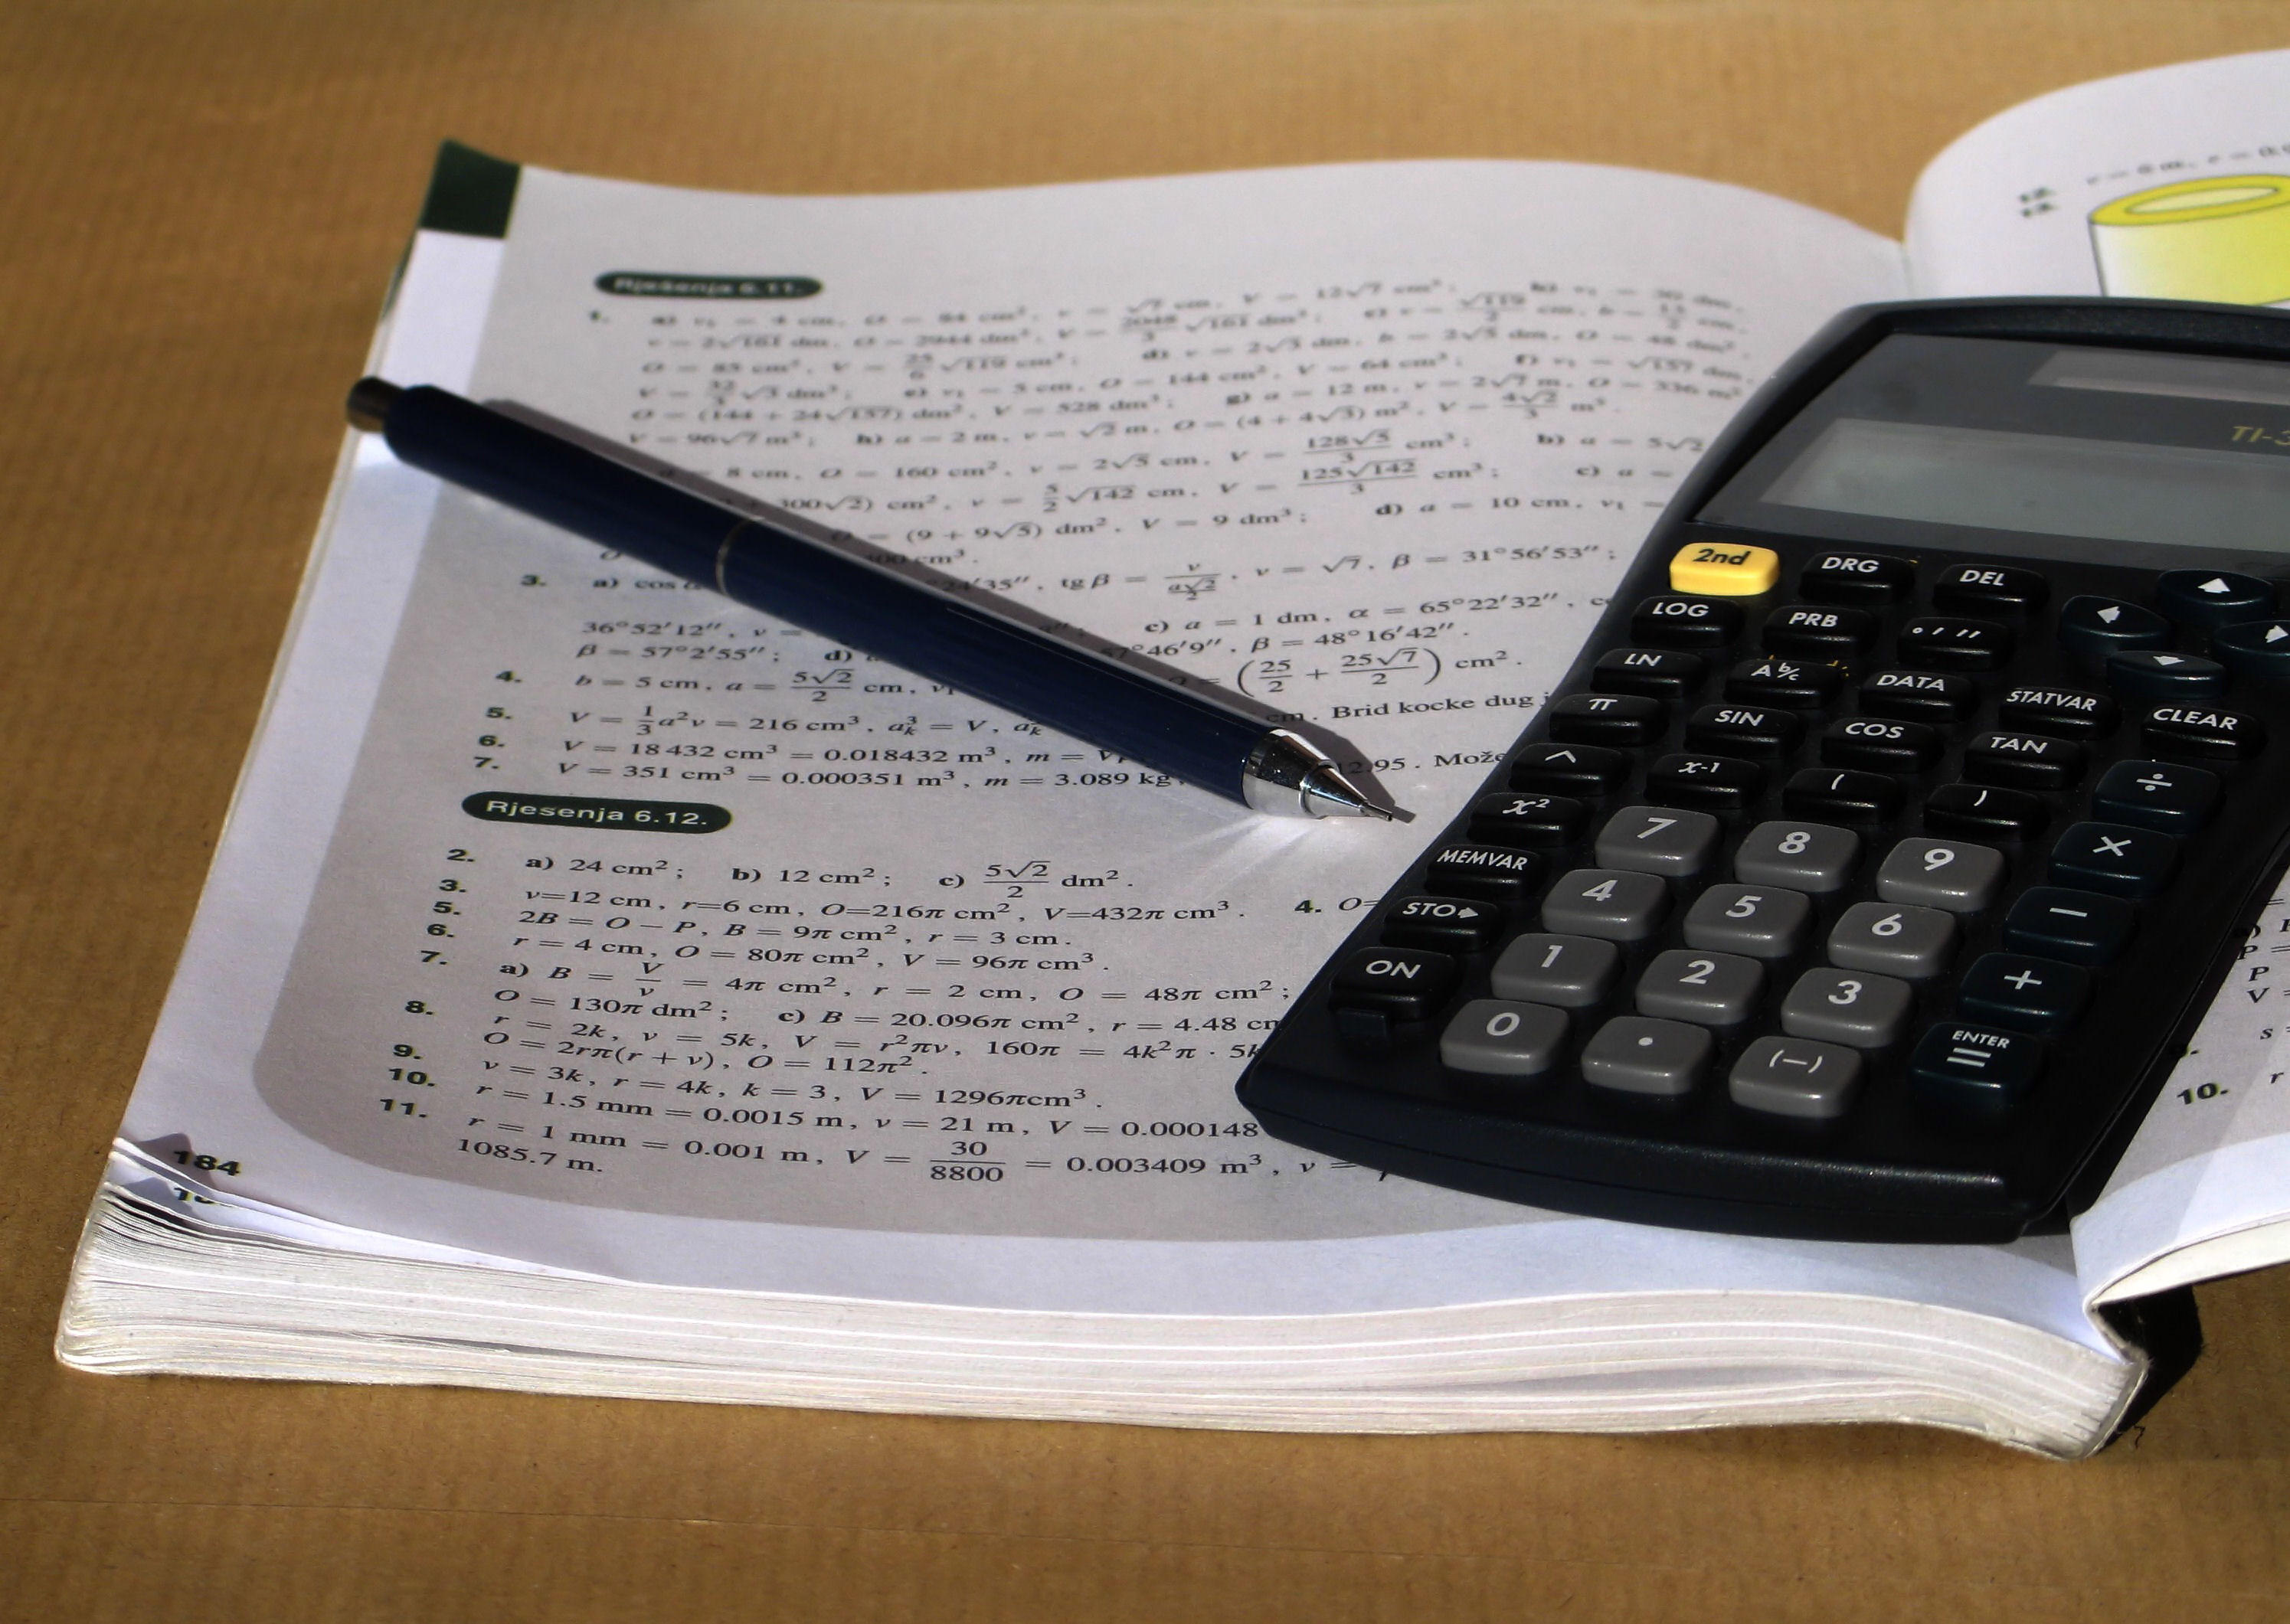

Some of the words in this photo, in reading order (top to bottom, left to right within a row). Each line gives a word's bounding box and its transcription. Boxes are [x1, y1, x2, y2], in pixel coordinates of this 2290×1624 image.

[1693, 547, 1752, 566] 2nd
[1821, 557, 1879, 573] DRG
[1959, 570, 2004, 587] DEL
[1652, 602, 1709, 617] LOG
[1788, 612, 1838, 627] PRB
[1624, 653, 1662, 667] LN
[1876, 675, 1945, 691] DATA
[2006, 690, 2097, 711] STATVAR
[1714, 710, 1764, 727] SIN
[2153, 708, 2238, 730] CLEAR
[1845, 722, 1905, 739] COS
[1991, 737, 2048, 754] TAN
[1637, 817, 1677, 839] 7
[1778, 832, 1811, 854] 8
[1436, 849, 1528, 871] MEMVAR
[1924, 848, 1955, 871] 9
[1582, 879, 1618, 901] 4
[1725, 895, 1762, 918] 5
[1871, 913, 1902, 936] 6
[1541, 945, 1563, 968] 1
[1366, 959, 1421, 979] ON
[1679, 959, 1716, 985] 2
[1828, 980, 1862, 1005] 3
[1487, 1012, 1520, 1037] 0
[1951, 1030, 2010, 1049] ENTER
